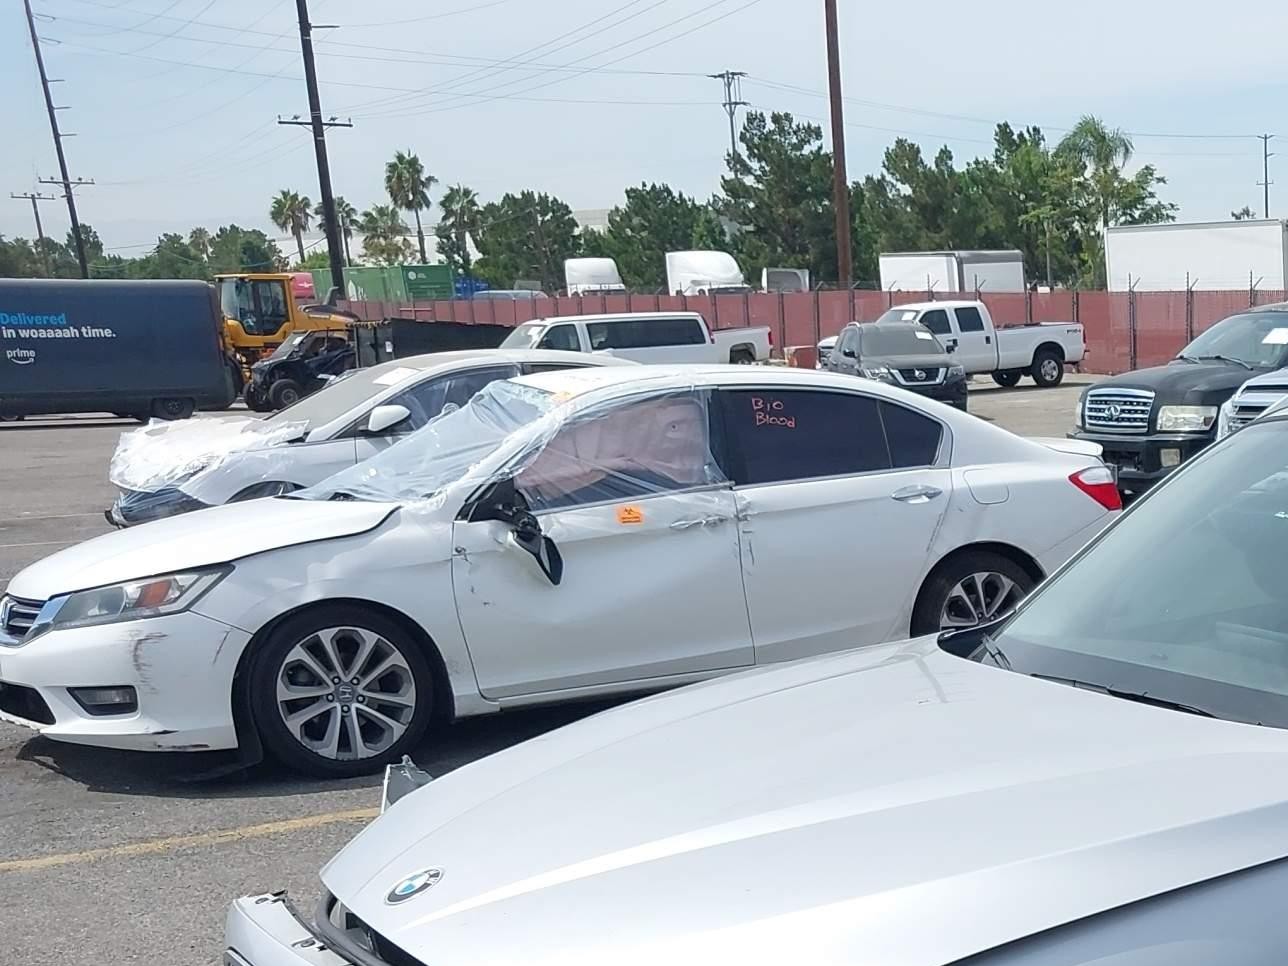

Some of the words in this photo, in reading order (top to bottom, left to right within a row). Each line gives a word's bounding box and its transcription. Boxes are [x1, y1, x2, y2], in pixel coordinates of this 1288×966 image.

[0, 313, 66, 325] Delivered
[2, 326, 16, 338] in
[18, 326, 79, 338] woaaaah
[81, 326, 116, 338] time.
[6, 347, 36, 359] prime
[756, 411, 795, 428] Blood
